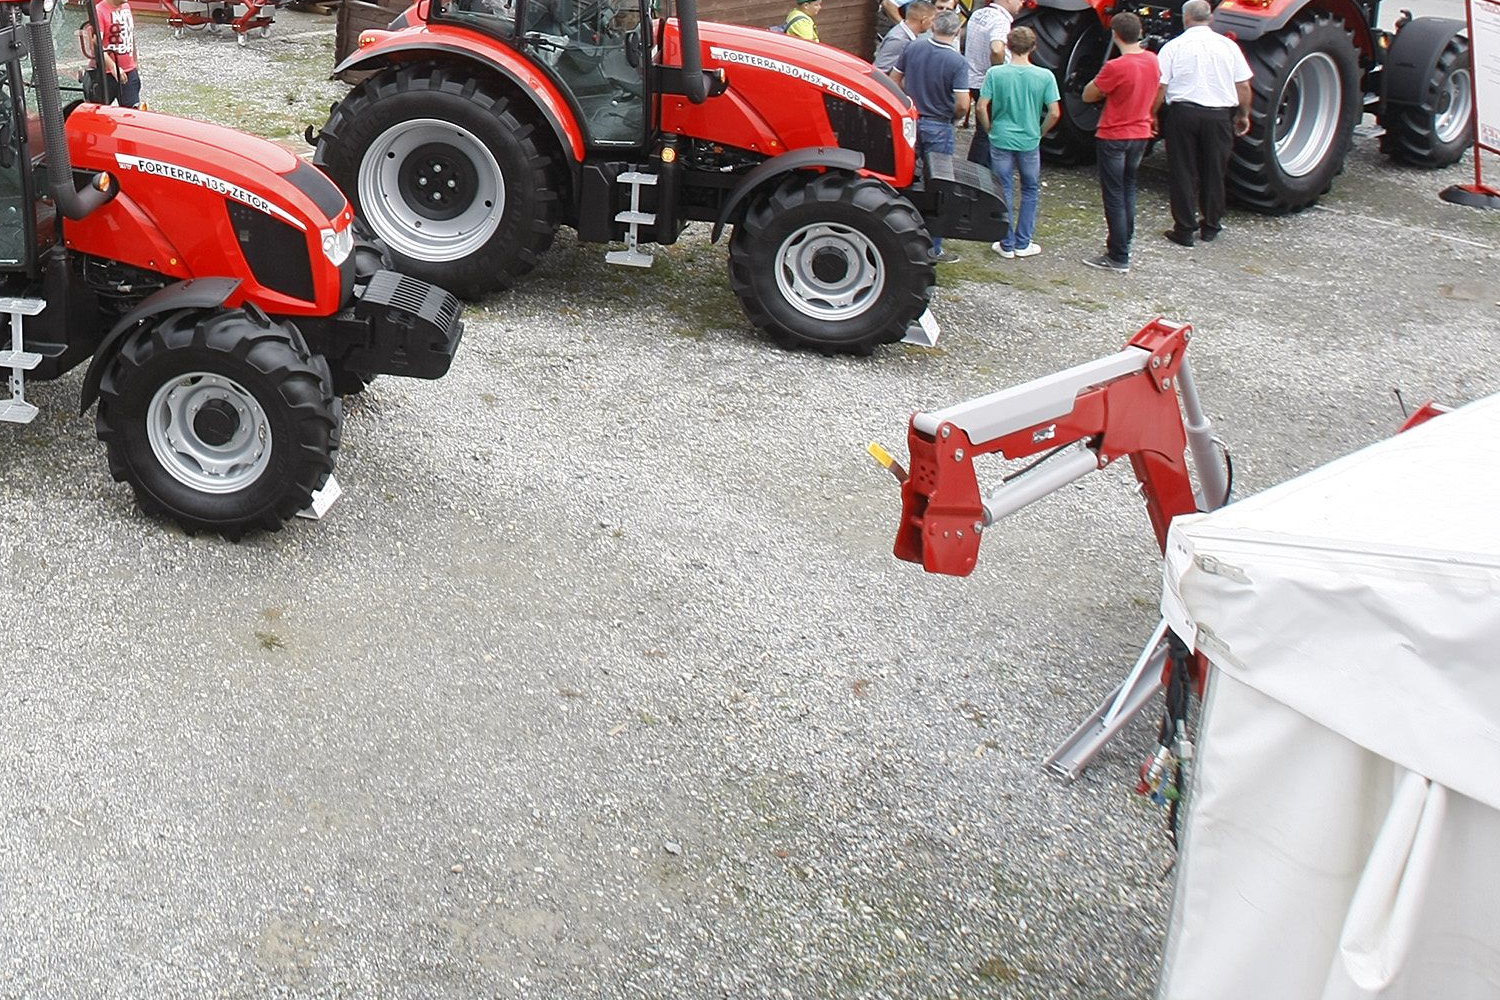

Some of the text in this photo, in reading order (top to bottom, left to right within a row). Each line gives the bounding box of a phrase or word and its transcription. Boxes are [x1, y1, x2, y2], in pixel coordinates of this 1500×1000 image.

[723, 51, 777, 70] FORTERRA
[780, 64, 799, 77] 130
[803, 72, 822, 85] HSX
[830, 81, 861, 103] ZETOR
[138, 160, 269, 212] FORTERRA 135 ZETOR
